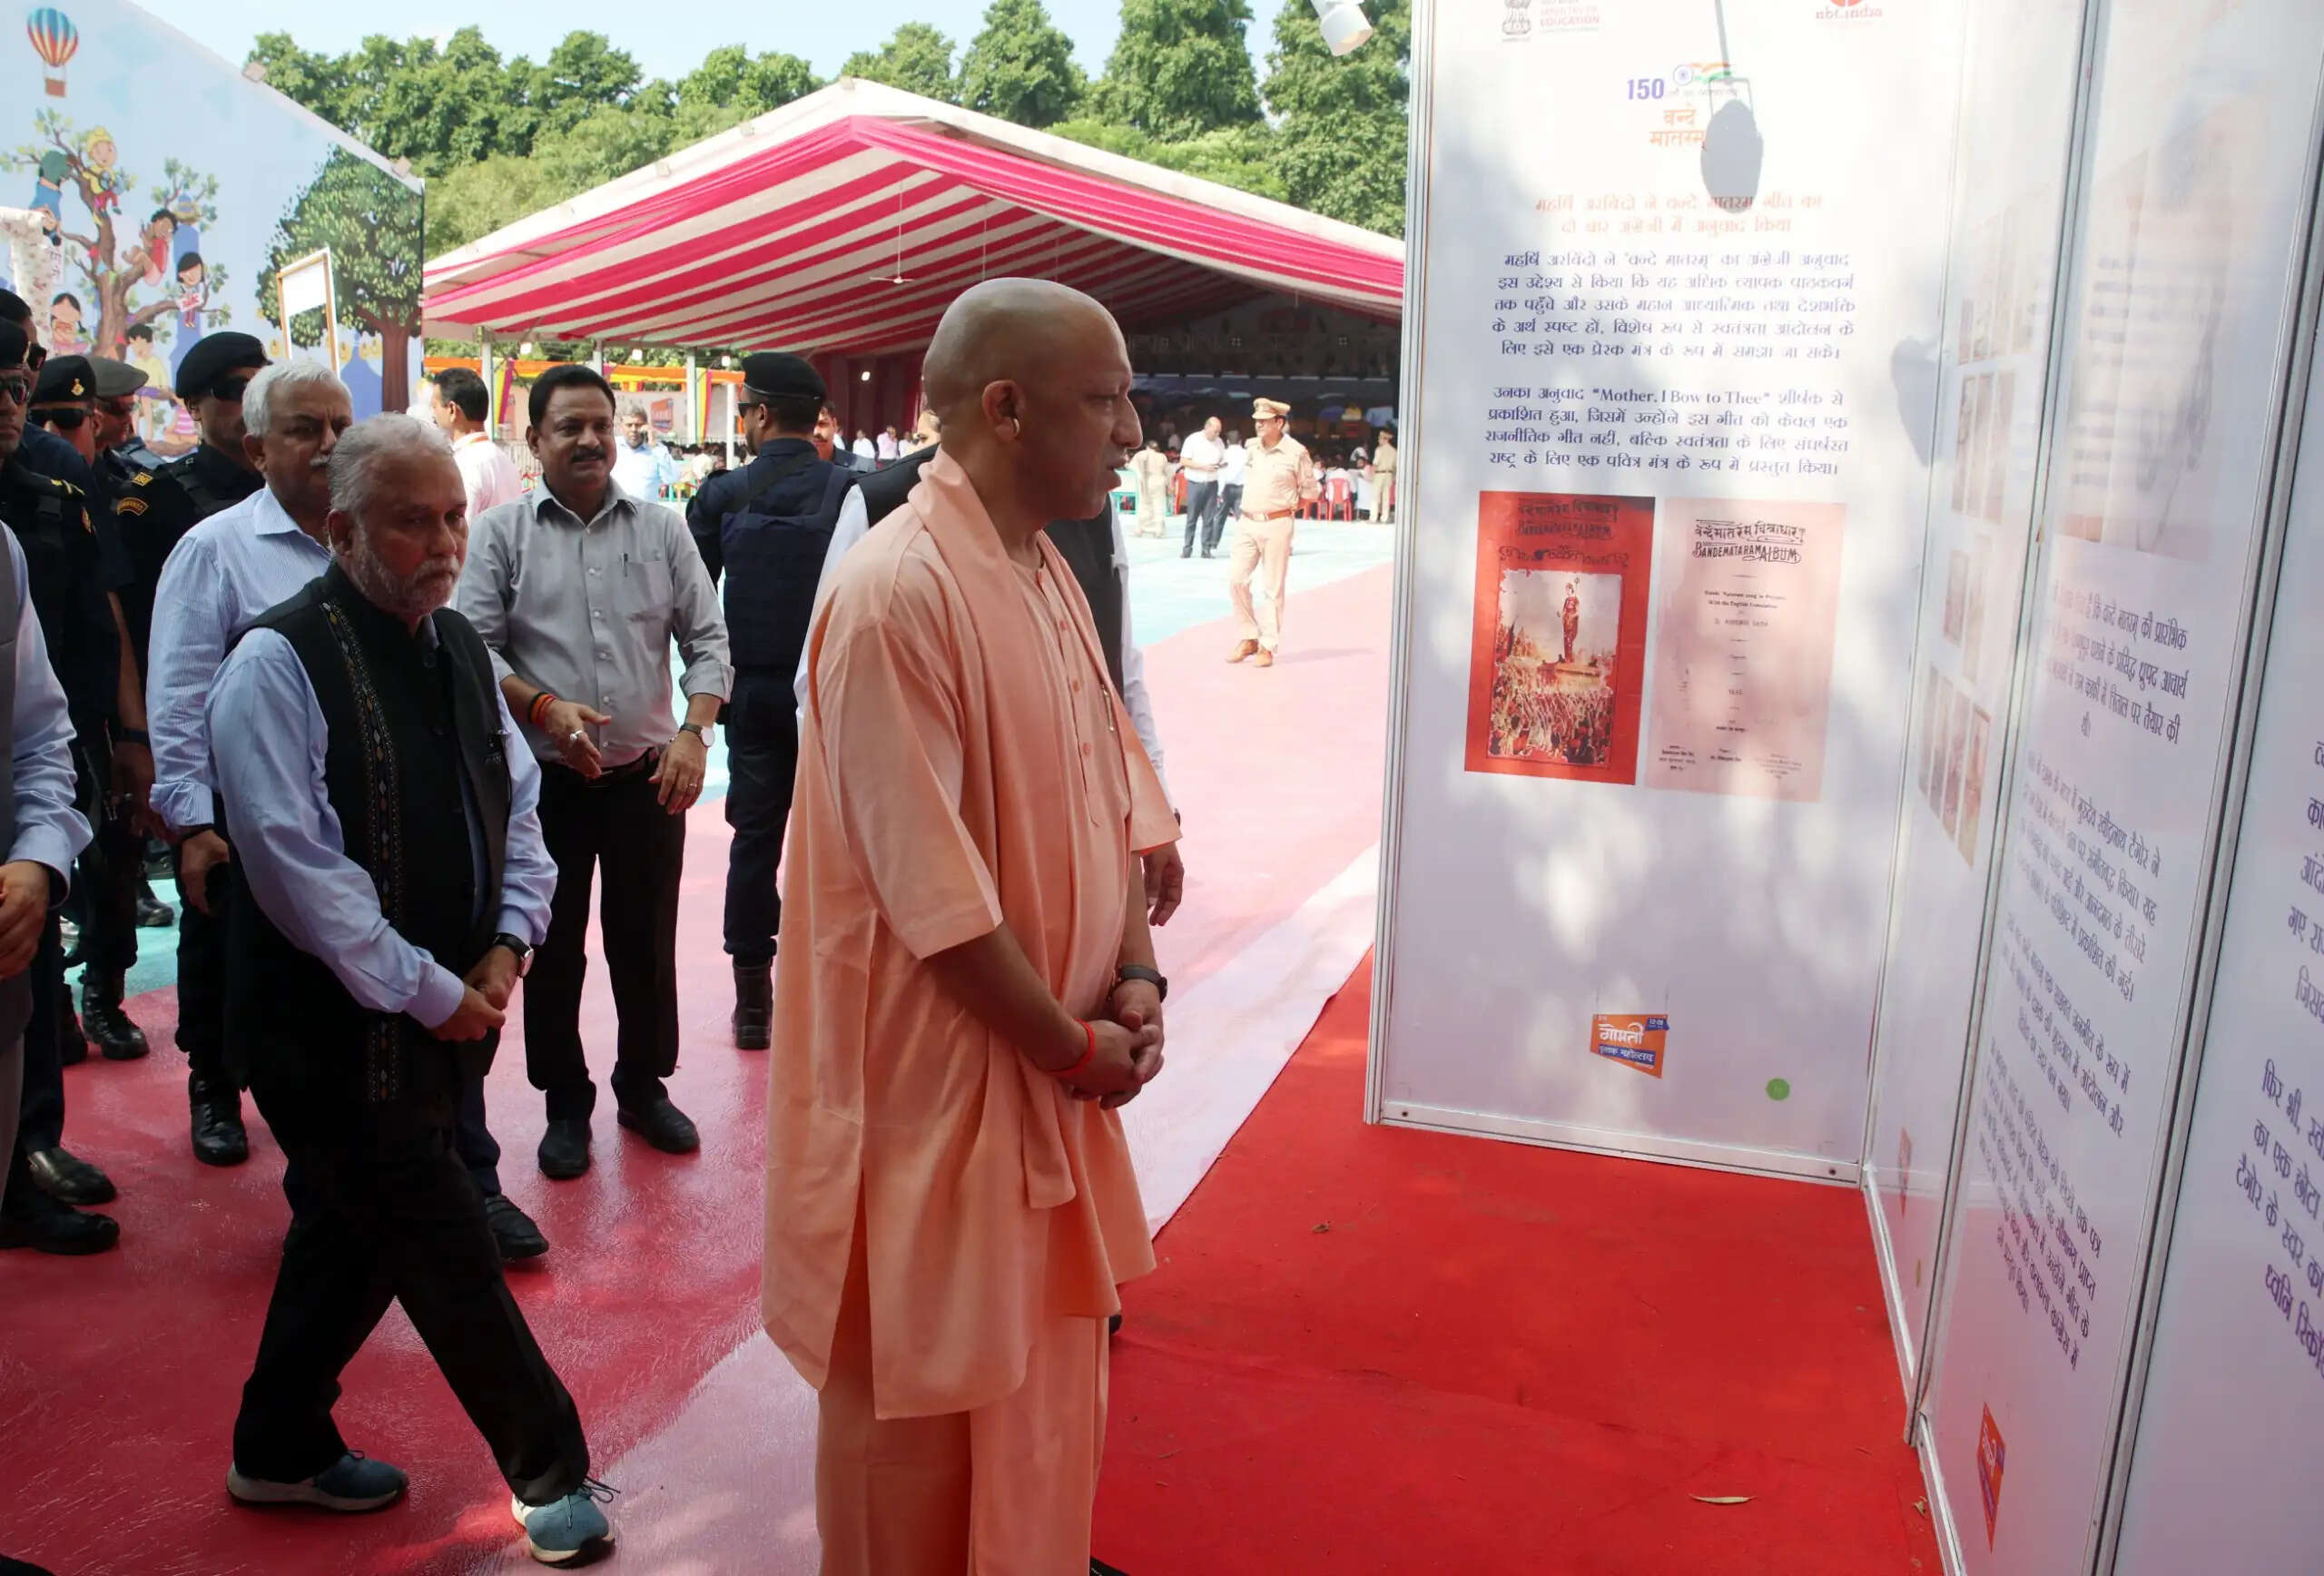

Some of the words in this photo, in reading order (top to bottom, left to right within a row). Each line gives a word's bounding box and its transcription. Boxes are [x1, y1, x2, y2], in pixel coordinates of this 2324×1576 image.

[1628, 78, 1665, 100] 150
[1498, 276, 1519, 290] इस
[1525, 273, 1562, 289] उद्देश्य
[1571, 272, 1582, 289] से
[1590, 272, 1623, 289] किया
[1631, 272, 1650, 289] कि
[1656, 276, 1678, 290] यह
[1685, 272, 1728, 289] अधिक
[1735, 276, 1783, 290] व्यापक
[1790, 272, 1855, 290] पाठकवर्ग
[1504, 251, 1540, 267] महर्षि
[1547, 251, 1596, 266] अरविंदो
[1603, 251, 1616, 266] ने
[1720, 253, 1739, 266] का
[1800, 253, 1849, 271] अनुवाद
[1494, 298, 1518, 311] तक
[1563, 296, 1587, 311] और
[1594, 296, 1629, 311] उसके
[1636, 299, 1672, 311] महान
[1684, 296, 1755, 312] आध्यात्मिक
[1764, 300, 1790, 312] तथा
[1797, 297, 1856, 312] देशभक्ति
[1492, 318, 1505, 333] के
[1513, 318, 1536, 333] अर्थ
[1544, 320, 1579, 333] स्पष्ट
[1613, 318, 1652, 334] विशेष
[1660, 321, 1683, 334] रूप
[1692, 319, 1703, 334] से
[1711, 320, 1767, 335] स्वतंत्रता
[1774, 320, 1831, 335] आंदोलन
[1838, 320, 1855, 335] के
[1502, 340, 1526, 355] लिए
[1532, 340, 1554, 356] इसे
[1562, 342, 1585, 356] एक
[1591, 340, 1624, 357] प्रेरक
[1630, 340, 1651, 357] मंत्र
[1659, 340, 1674, 357] के
[1683, 345, 1704, 357] रूप
[1712, 341, 1724, 358] में
[1733, 346, 1773, 359] समझा
[1782, 346, 1797, 359] जा
[1806, 343, 1840, 359] सके।
[1488, 405, 1542, 421] प्रकाशित
[1549, 409, 1579, 426] हुआ,
[1587, 407, 1627, 423] जिसमें
[1634, 408, 1679, 425] उन्होंने
[1688, 413, 1709, 426] इस
[1716, 409, 1743, 427] गीत
[1750, 411, 1769, 427] को
[1777, 411, 1816, 428] केवल
[1824, 416, 1851, 429] एक
[1492, 387, 1531, 399] उनका
[1538, 387, 1584, 403] अनुवाद
[1661, 389, 1666, 403] I
[1670, 390, 1700, 403] Bow
[1706, 390, 1721, 404] to
[1778, 389, 1823, 405] शीर्षक
[1831, 389, 1844, 406] से
[1485, 427, 1551, 443] राजनीतिक
[1557, 428, 1583, 444] गीत
[1629, 430, 1668, 446] बल्कि
[1675, 433, 1728, 449] स्वतंत्रता
[1737, 433, 1750, 449] के
[1760, 434, 1787, 450] लिए
[1794, 435, 1849, 452] संघर्षरत
[1488, 451, 1516, 468] राष्ट्र
[1523, 449, 1538, 465] के
[1545, 449, 1571, 467] लिए
[1577, 454, 1600, 467] एक
[1606, 452, 1641, 468] पवित्र
[1648, 453, 1669, 469] मंत्र
[1676, 454, 1690, 470] के
[1699, 458, 1721, 471] रूप
[1728, 455, 1740, 471] में
[1748, 460, 1791, 477] प्रस्तुत
[1798, 458, 1838, 475] किया।
[2140, 610, 2153, 640] की
[2153, 617, 2187, 652] प्रारंभिक
[2138, 661, 2159, 692] ध्रुपद
[2161, 669, 2190, 700] आचार्य
[2130, 701, 2142, 726] पर
[2142, 701, 2163, 737] तैयार
[2165, 713, 2181, 745] की
[2128, 830, 2149, 871] टैगोर
[2151, 845, 2161, 879] ने
[2118, 871, 2139, 911] किया।
[2142, 896, 2157, 928] यह
[2076, 927, 2104, 970] प्रकाशित
[2104, 954, 2116, 984] की
[2124, 923, 2146, 964] तीसरे
[2105, 1052, 2120, 1084] रूप
[2262, 1059, 2284, 1108] फिर
[2080, 1069, 2108, 1118] आंदोलन
[2108, 1103, 2124, 1139] और
[2254, 1118, 2270, 1156] का
[2273, 1140, 2293, 1178] एक
[2236, 1152, 2262, 1211] टैगोर
[2266, 1189, 2279, 1228] के
[2282, 1218, 2304, 1269] स्वर
[2075, 1205, 2089, 1235] एक
[2089, 1221, 2102, 1259] पत्र
[2077, 1260, 2097, 1301] प्राप्त
[2266, 1263, 2294, 1322] ध्वनि
[2065, 1285, 2079, 1324] गीत
[2080, 1309, 2090, 1339] के
[2071, 1339, 2079, 1372] में
